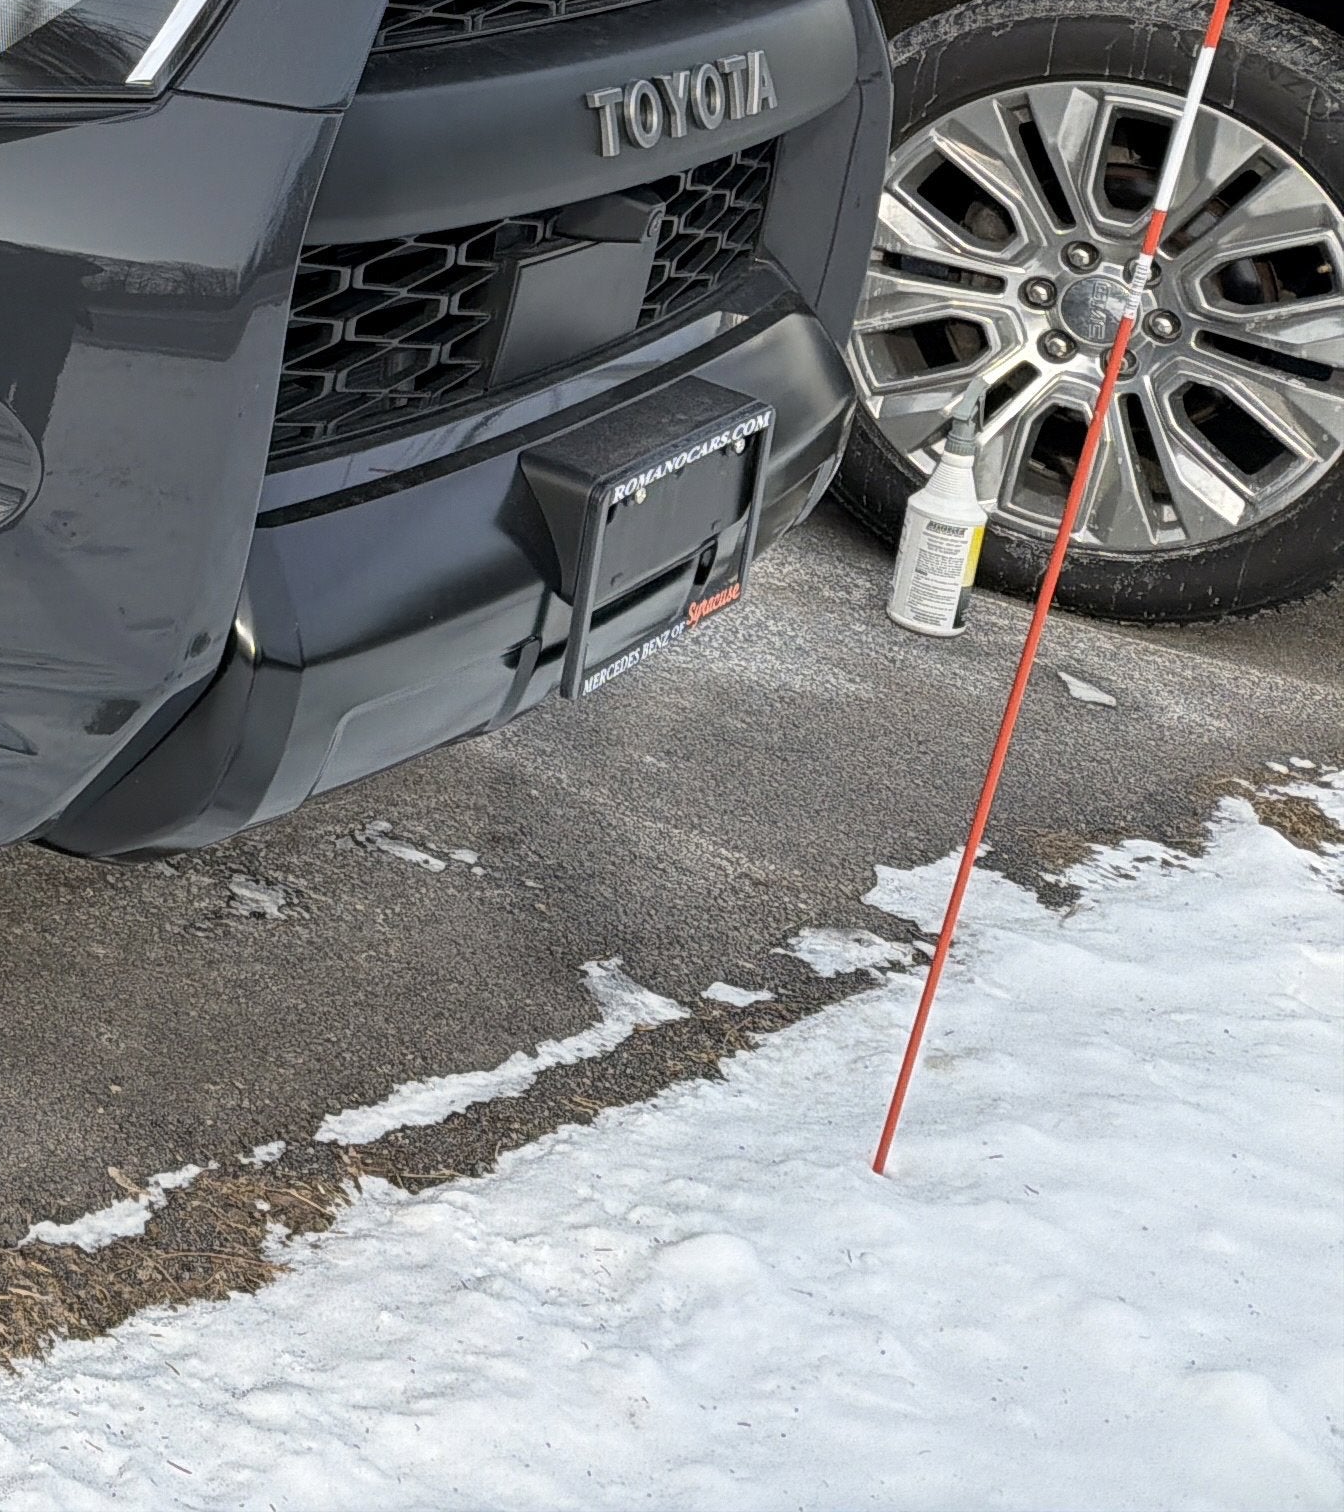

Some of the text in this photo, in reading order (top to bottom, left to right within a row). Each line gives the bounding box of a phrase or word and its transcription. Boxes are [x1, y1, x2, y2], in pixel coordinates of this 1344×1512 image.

[585, 49, 778, 158] TOYOTA
[612, 410, 772, 505] ROMANOCARS.COM
[582, 582, 742, 697] MERCEDES BENZ OF Syracuse
